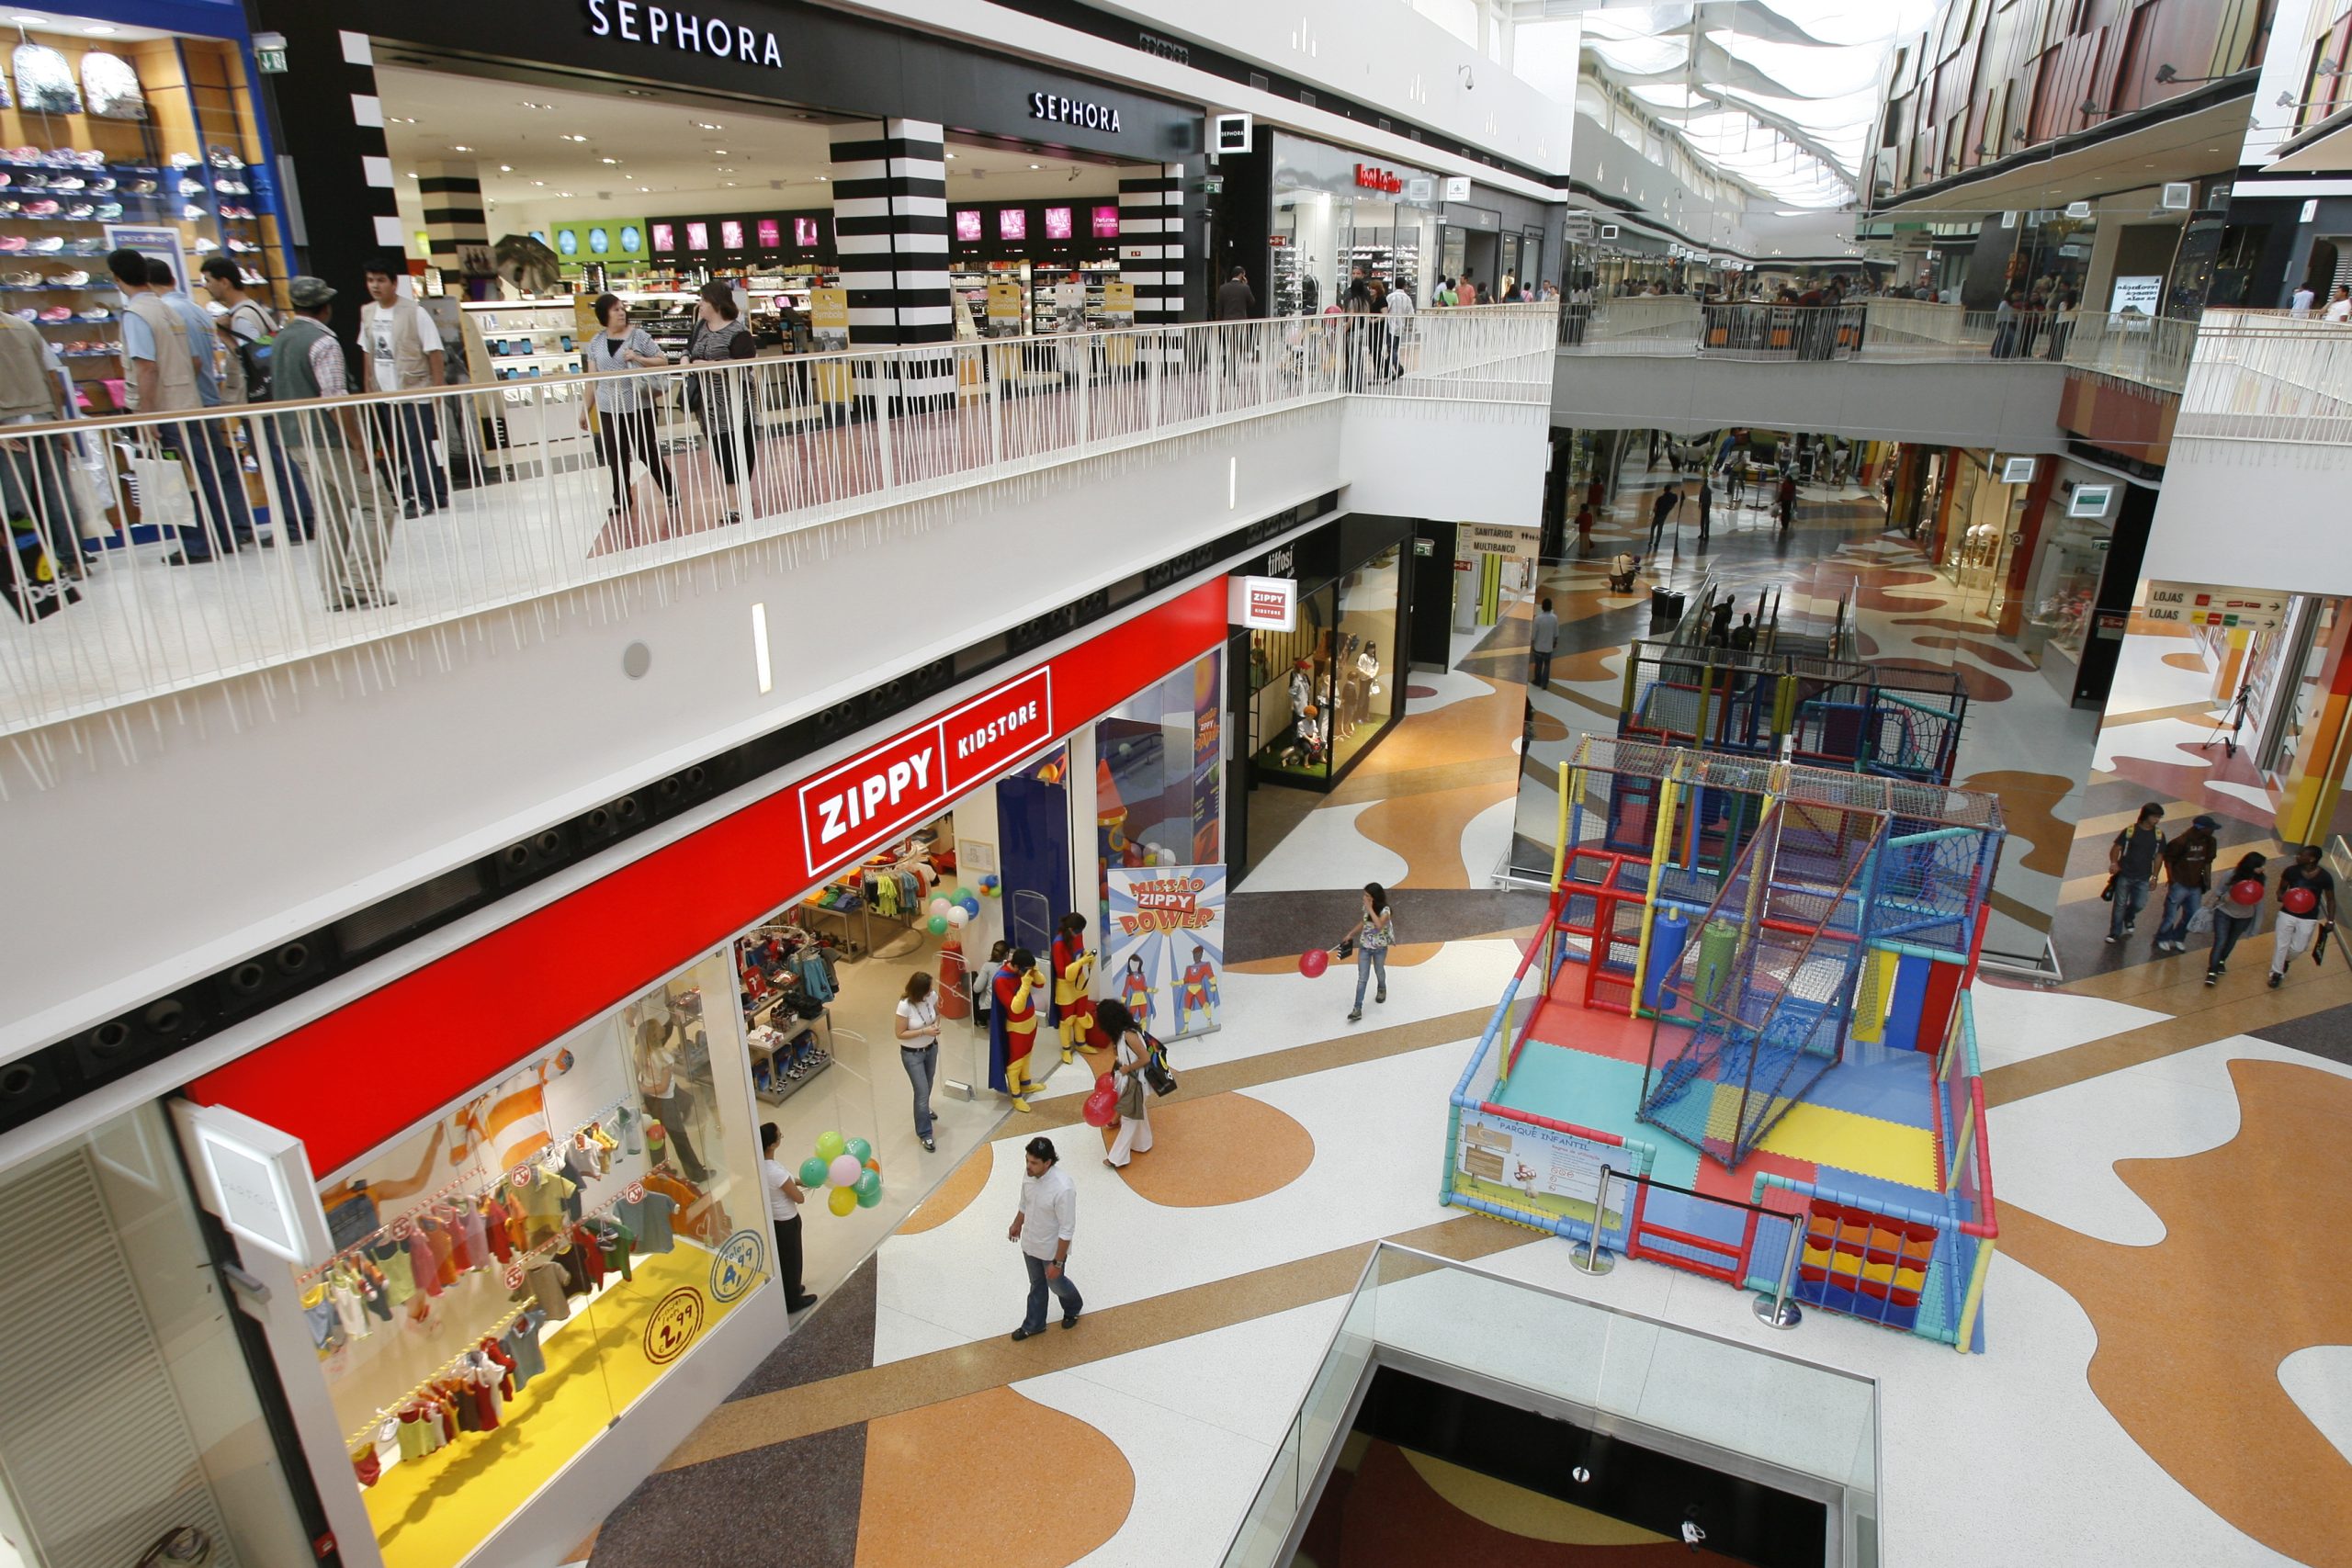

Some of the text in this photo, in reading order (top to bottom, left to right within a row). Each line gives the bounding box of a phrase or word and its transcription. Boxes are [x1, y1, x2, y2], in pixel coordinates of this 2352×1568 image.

[588, 0, 783, 69] SEPHORA
[1035, 92, 1121, 132] SEPHORA
[1474, 527, 1513, 539] SANITÁRIOS
[1473, 541, 1516, 554] MULTIBANCO
[1253, 592, 1284, 604] ZIPPY
[2154, 591, 2184, 604] LOJAS
[1254, 607, 1282, 616] KIDSTORE
[2149, 608, 2179, 621] LOJAS
[957, 700, 1037, 759] KIDSTORE
[819, 747, 933, 845] ZIPPY
[1128, 876, 1205, 897] MISSÃO
[1139, 893, 1192, 908] ZIPPY
[1118, 908, 1216, 936] POWER
[1499, 1122, 1537, 1138] PARQUE
[1541, 1133, 1590, 1151] INFANTIL
